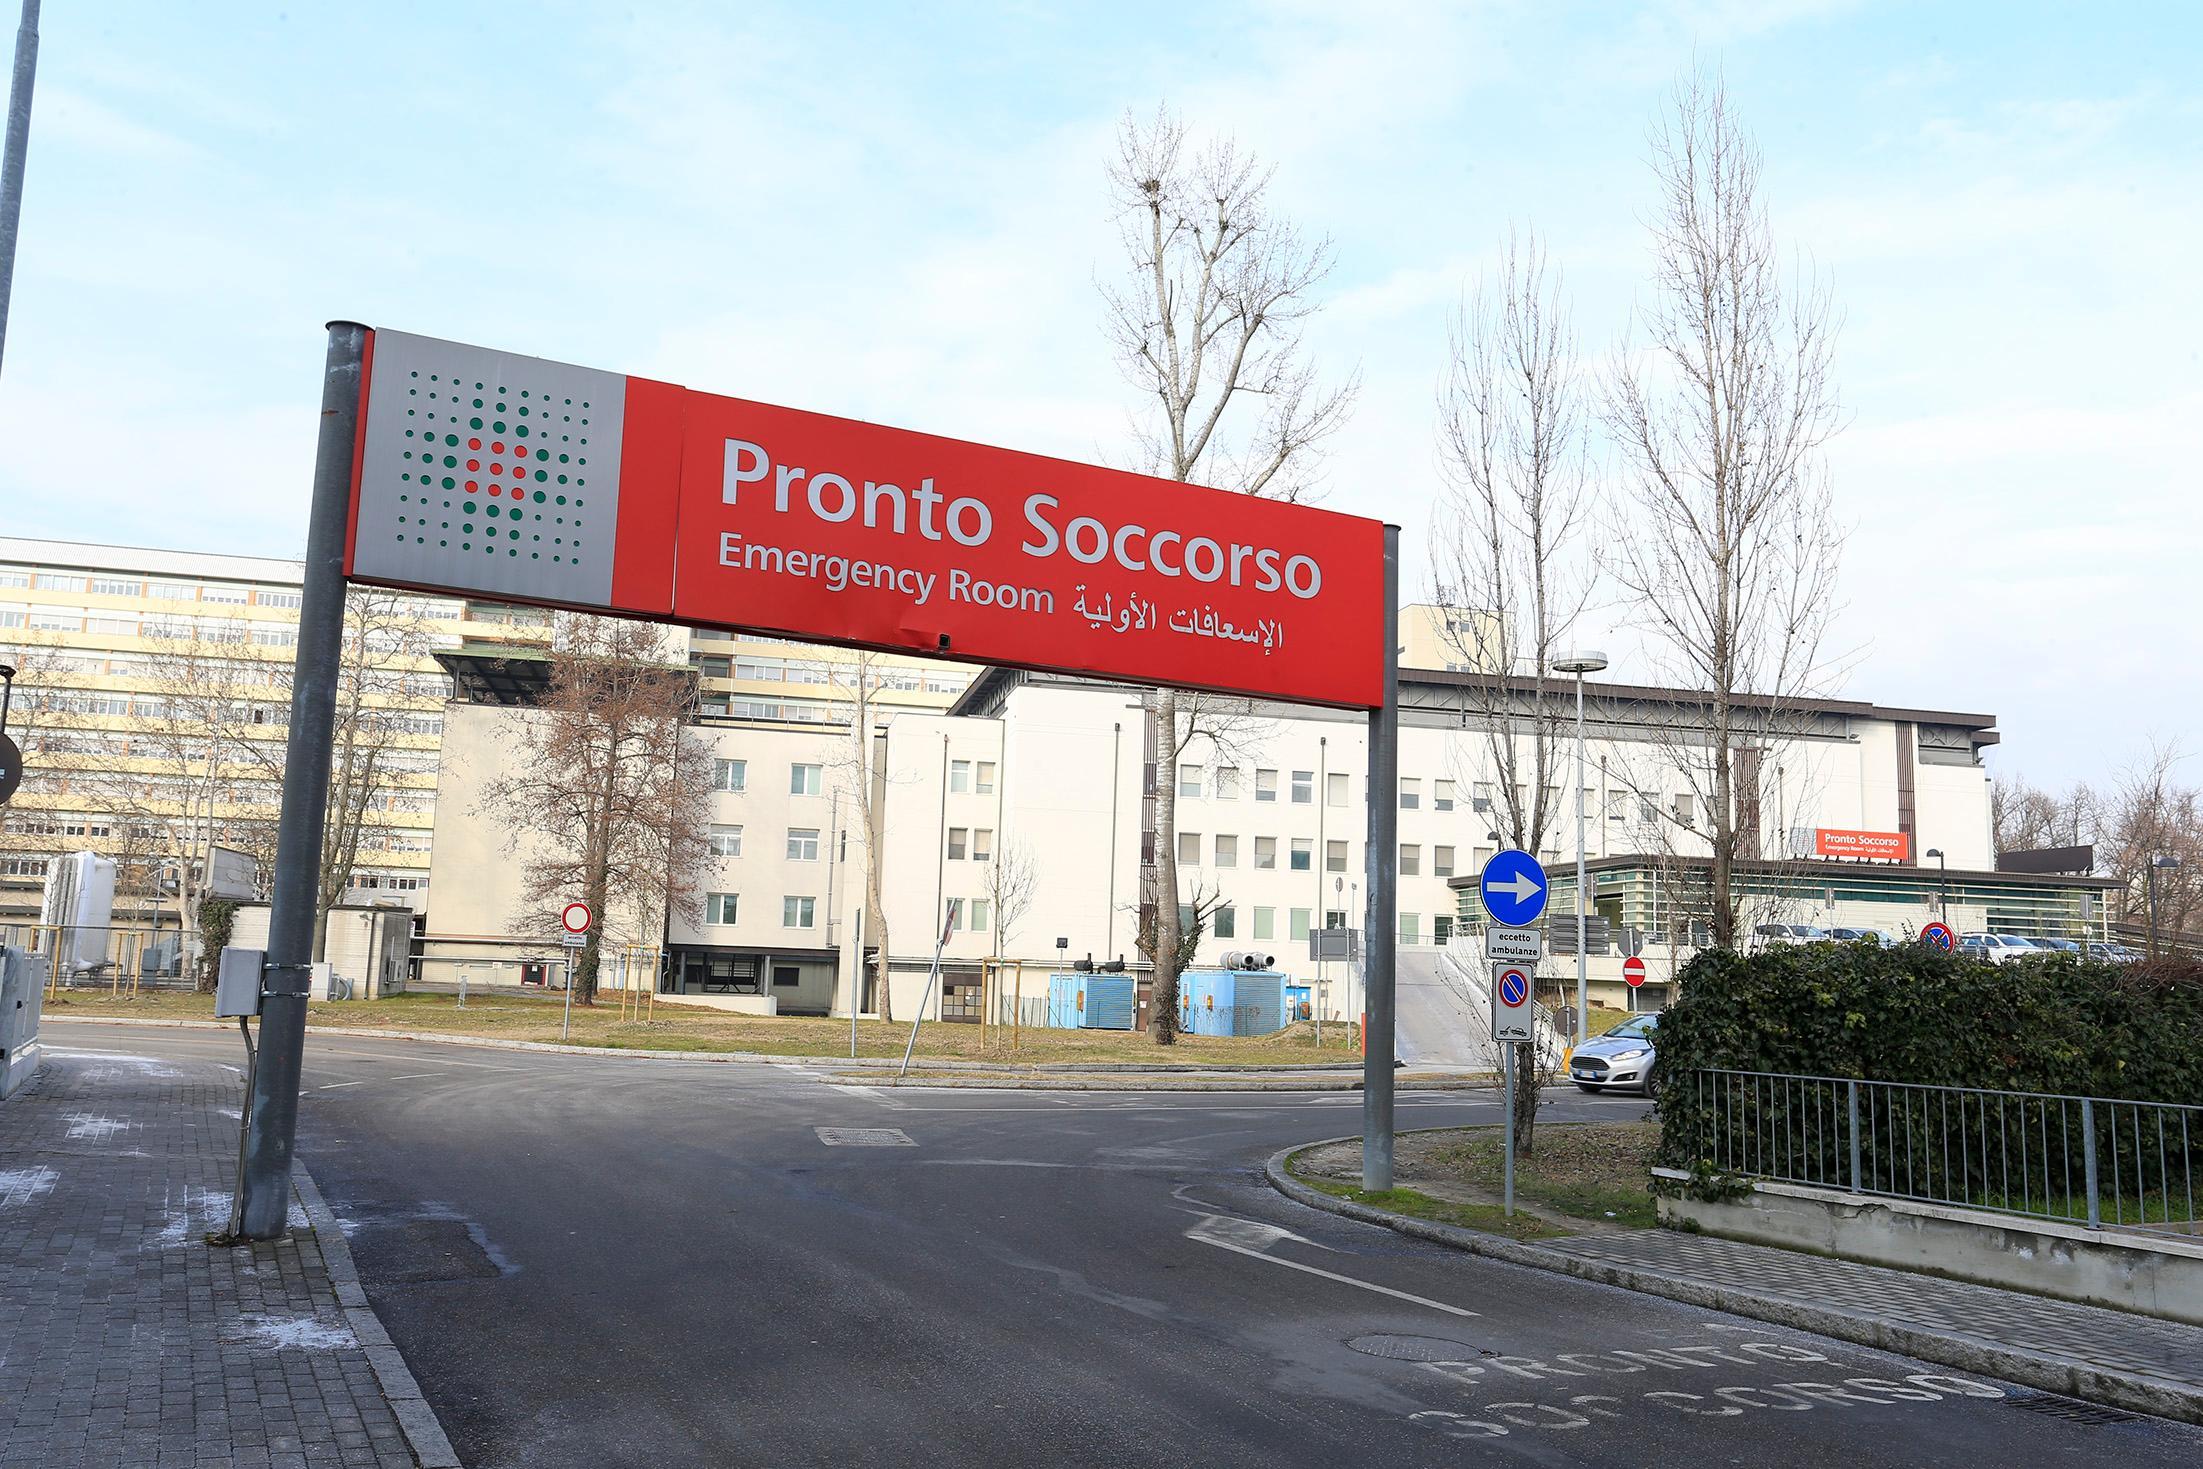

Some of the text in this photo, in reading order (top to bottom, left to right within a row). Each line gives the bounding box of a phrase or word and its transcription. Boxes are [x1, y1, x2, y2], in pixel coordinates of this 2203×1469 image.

[722, 438, 1323, 599] Pronto Soccorso
[719, 532, 1055, 614] Emergency Room
[1073, 584, 1284, 656] الإسعافات الأولية
[1825, 833, 1899, 847] Pronto Soccorso
[1491, 946, 1538, 956] ambulanze
[1499, 934, 1531, 942] eccetto
[1411, 1343, 1829, 1384] PRONTO
